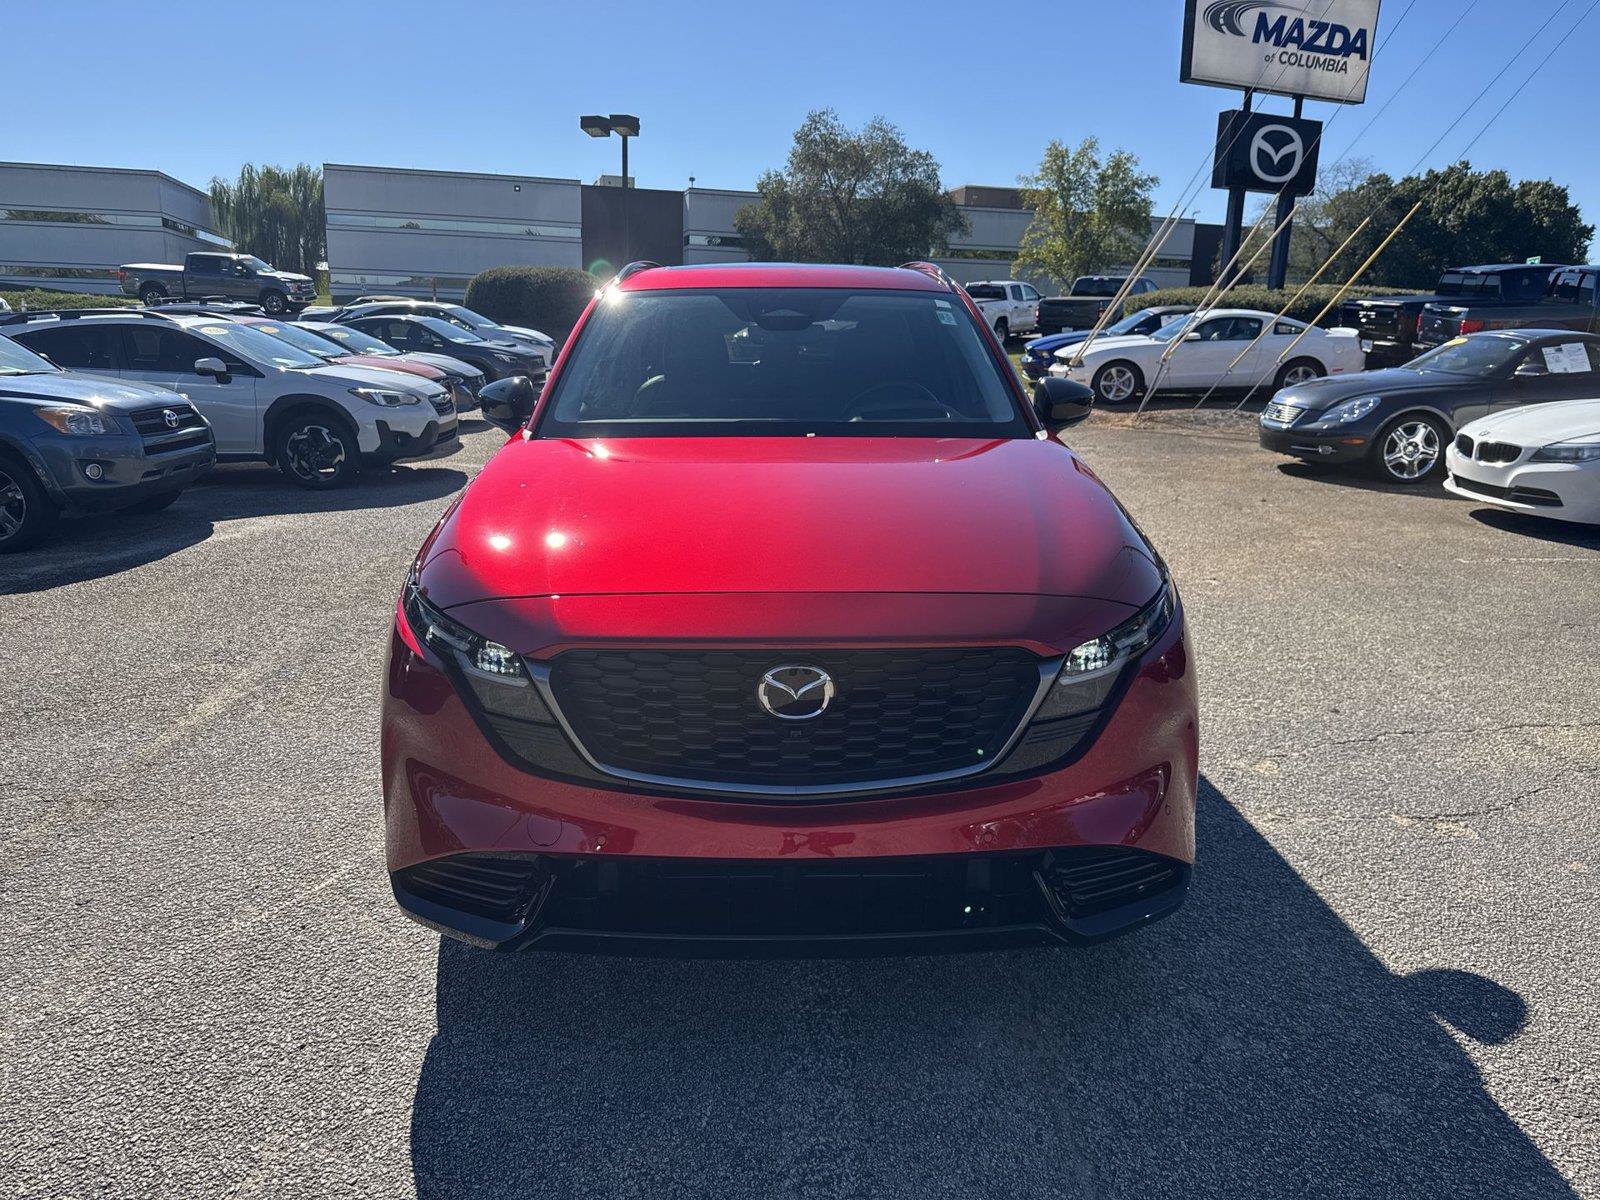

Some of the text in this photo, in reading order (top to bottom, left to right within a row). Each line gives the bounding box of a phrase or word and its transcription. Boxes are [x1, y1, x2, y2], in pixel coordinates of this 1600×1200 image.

[1252, 12, 1367, 60] MAZDA
[1264, 51, 1348, 74] of COLUMBIA
